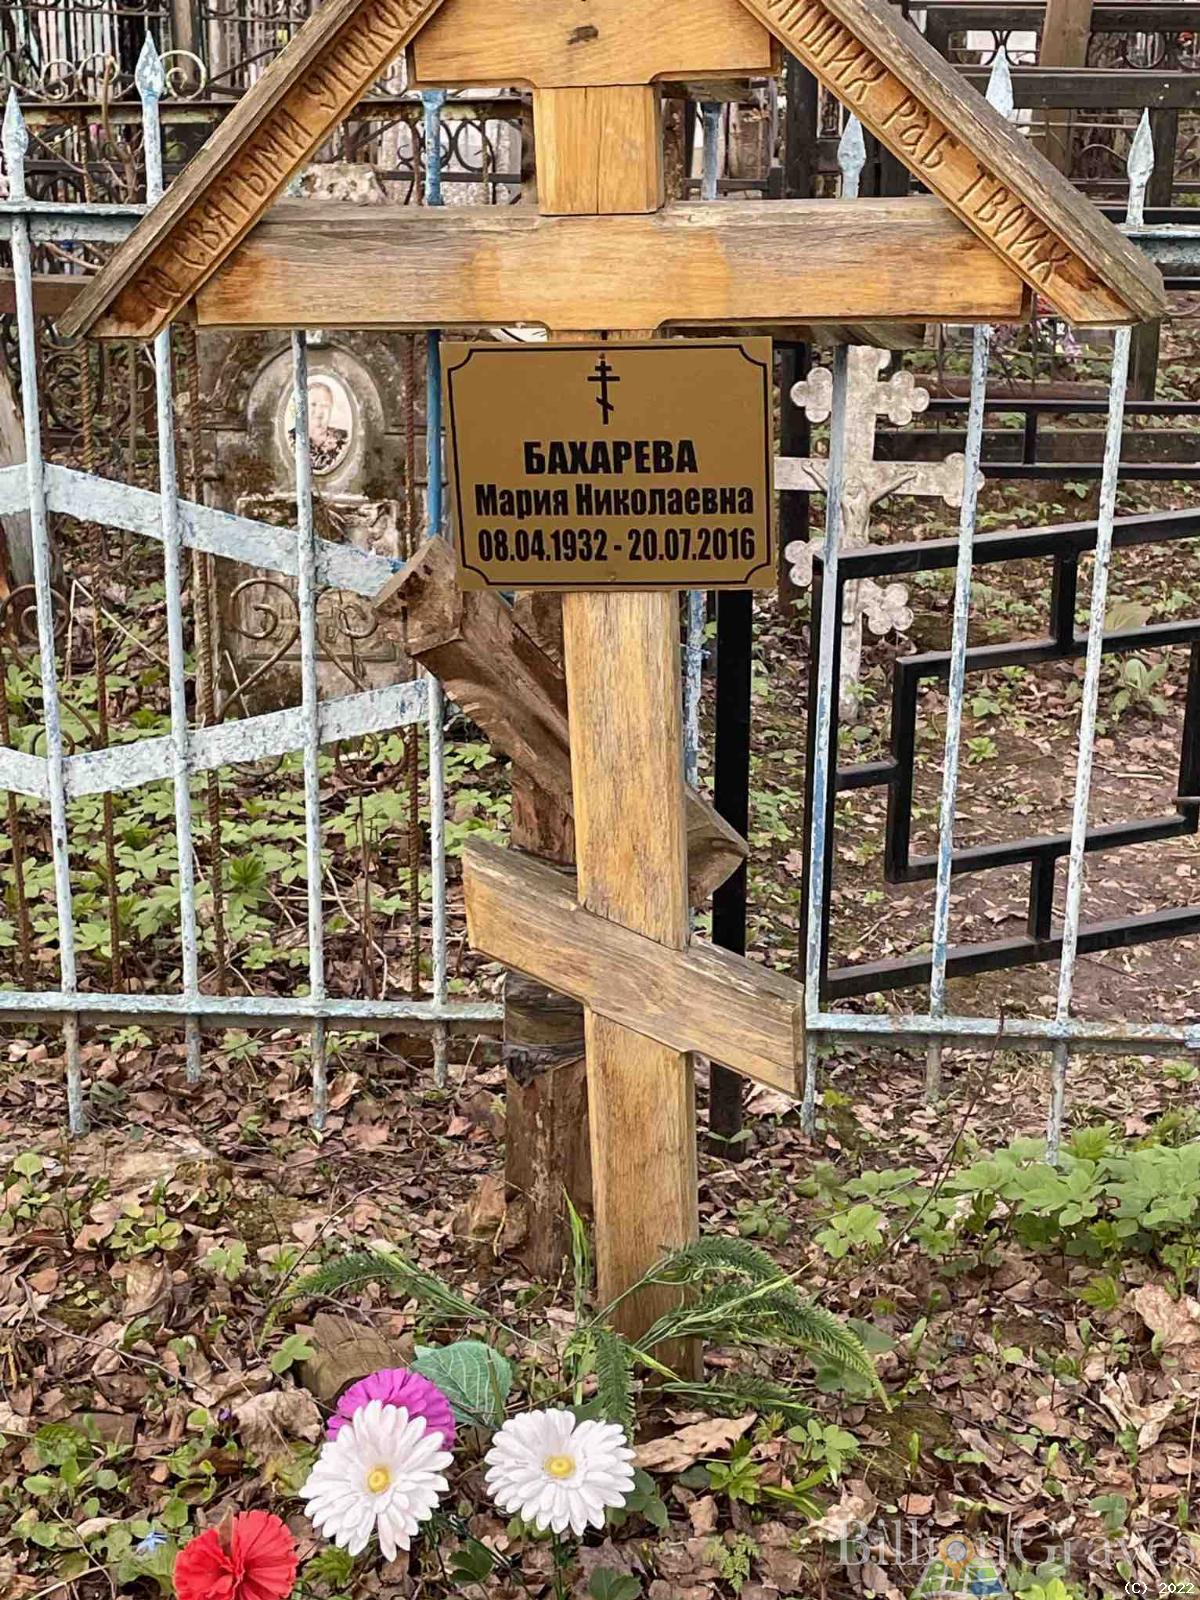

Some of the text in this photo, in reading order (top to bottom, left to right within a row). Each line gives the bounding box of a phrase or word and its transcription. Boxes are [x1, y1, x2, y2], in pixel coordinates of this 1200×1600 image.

[766, 0, 888, 102] ПШИХ
[956, 163, 1072, 285] ТВОИХ
[173, 108, 314, 270] СВЯТЫМИ
[524, 440, 698, 475] БАХАРЕВА
[475, 484, 754, 520] Мария Николаевна
[478, 529, 608, 562] 08.04.1932
[628, 528, 756, 561] 20.07.2016
